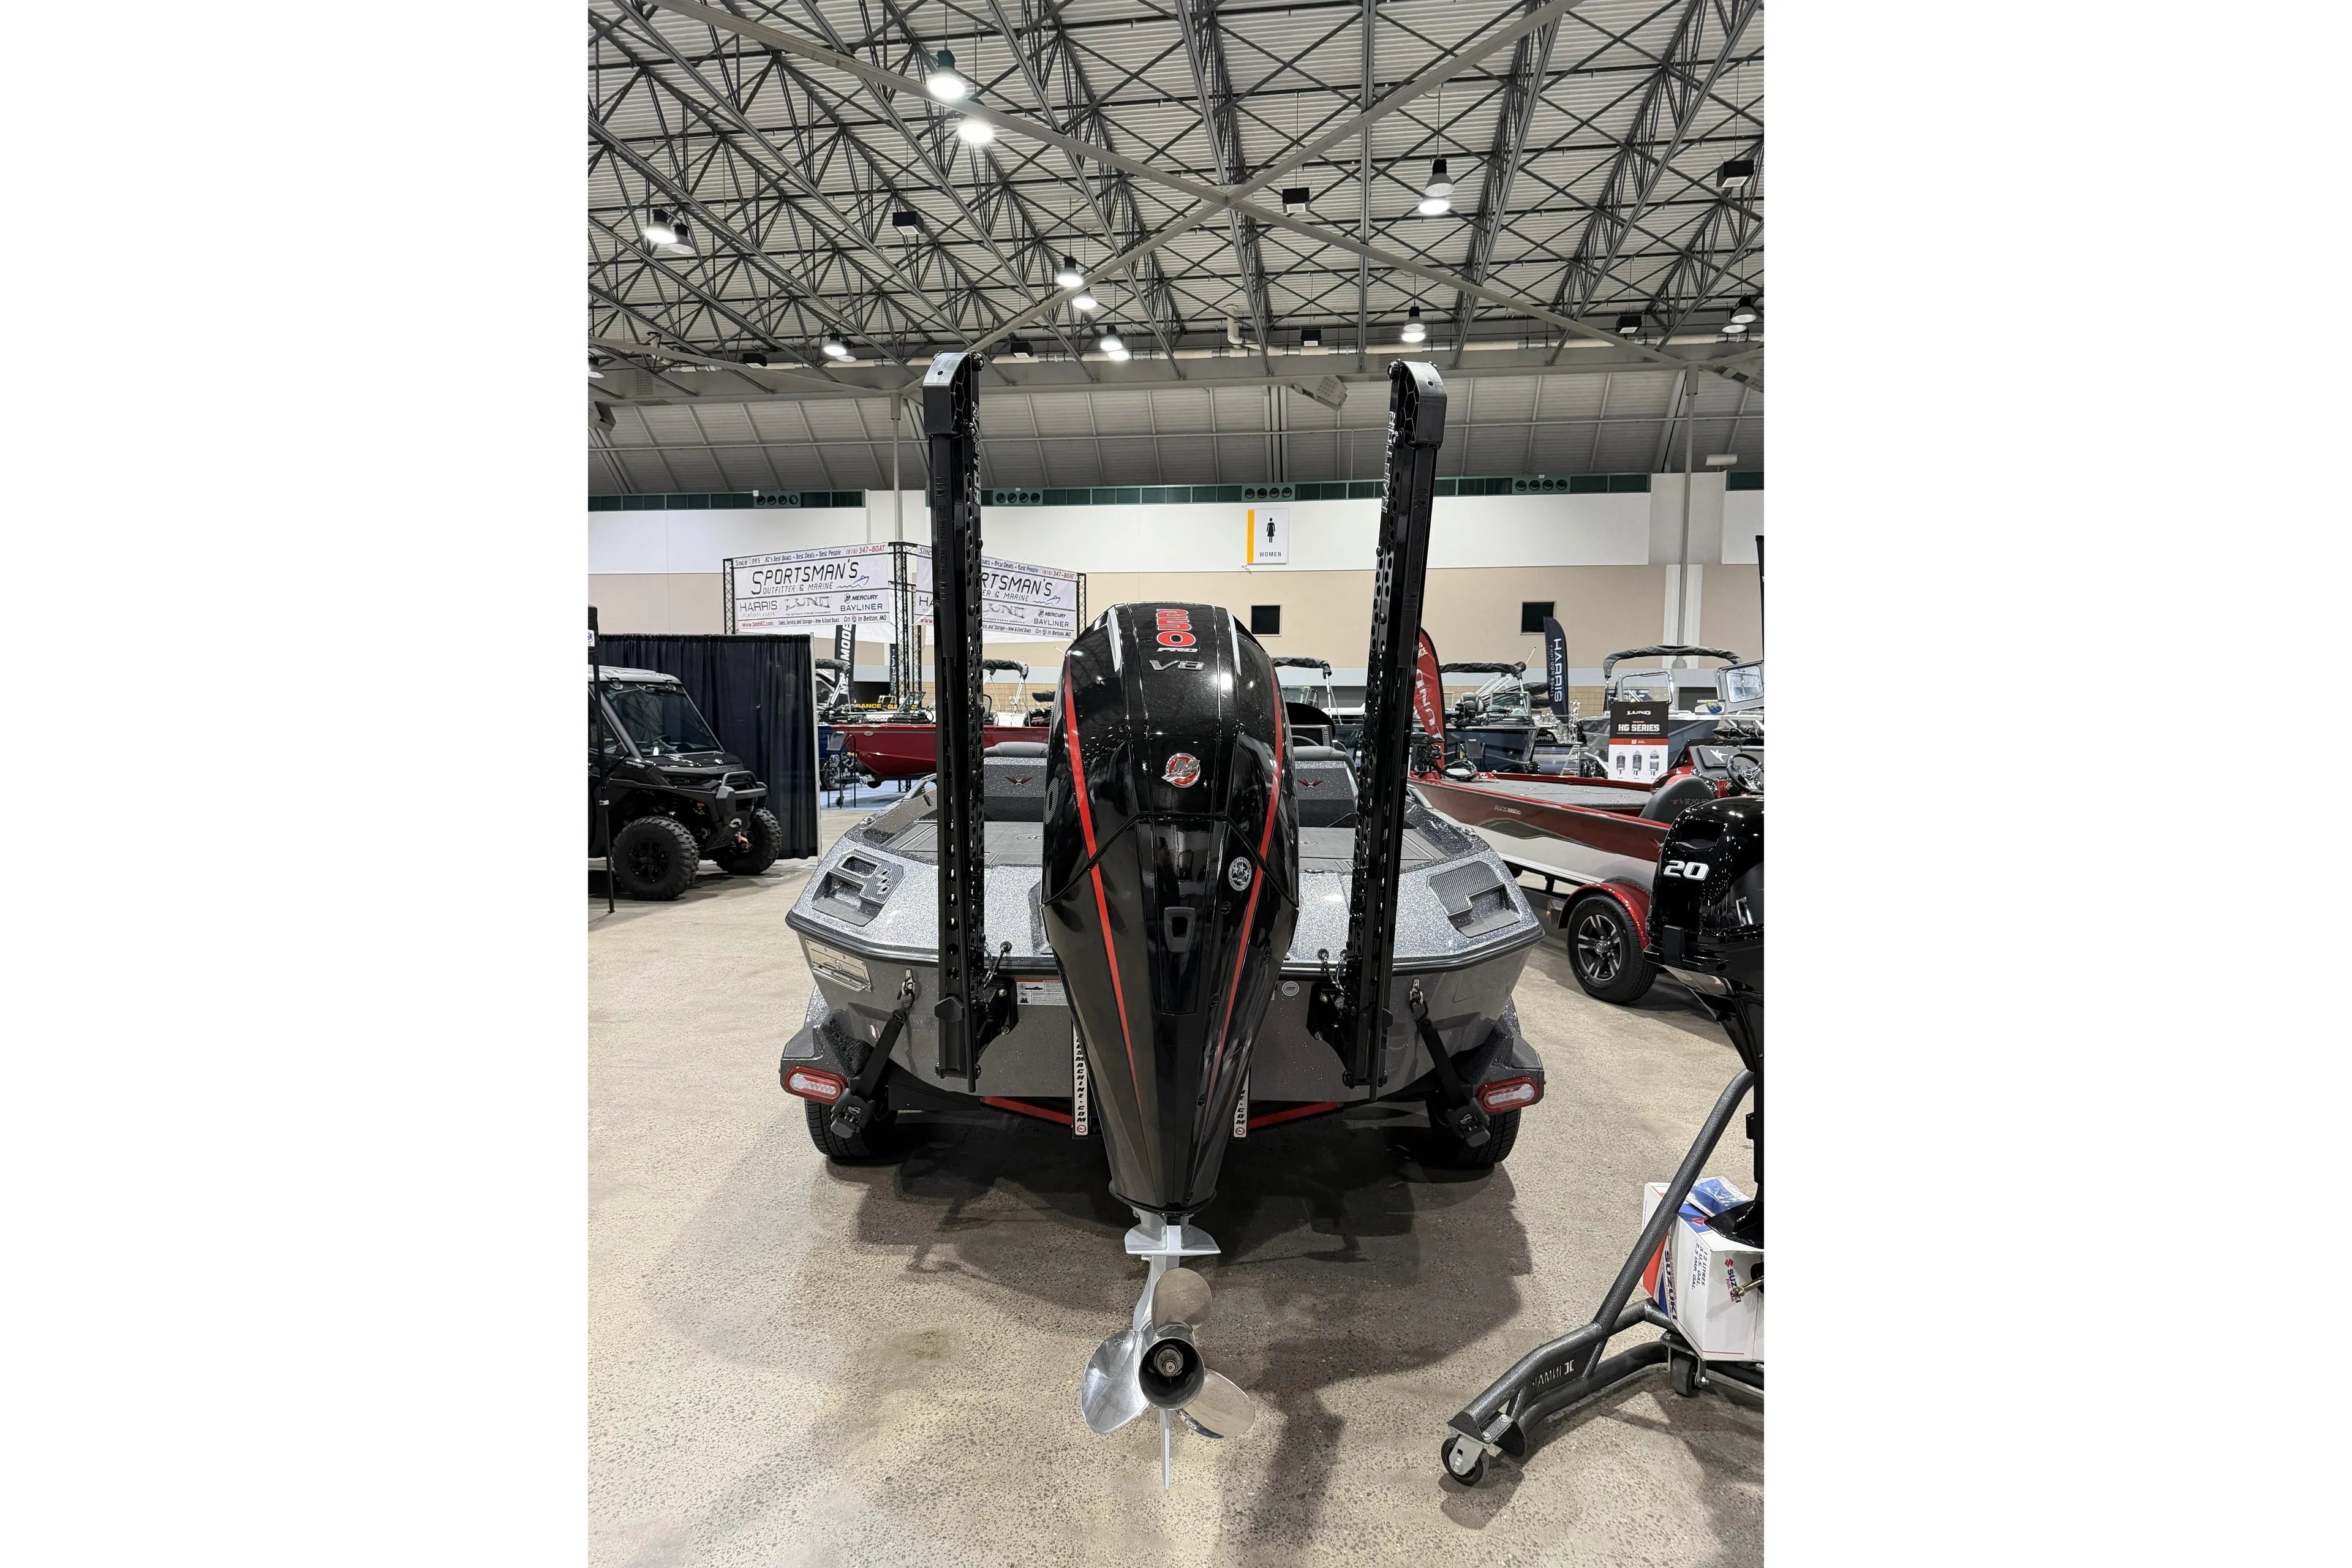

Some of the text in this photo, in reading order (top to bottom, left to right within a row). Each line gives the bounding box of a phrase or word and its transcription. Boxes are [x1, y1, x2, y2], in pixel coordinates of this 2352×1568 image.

[919, 548, 932, 556] Sinc
[751, 558, 859, 595] SPORTSMAN'S
[763, 585, 796, 594] OUTFITTER
[807, 582, 834, 591] MARINE
[981, 571, 1053, 597] RTSMAN'S
[1003, 592, 1030, 602] MARINE
[739, 600, 778, 612] HARRIS
[840, 603, 883, 612] BAYLINER
[1033, 618, 1069, 628] BAYLINER
[1155, 608, 1196, 647] 250
[1148, 659, 1205, 671] V8
[1553, 638, 1562, 703] HARRIS
[1618, 723, 1660, 732] HG SERIES
[1664, 859, 1710, 881] 20
[1703, 1250, 1708, 1261] 12
[1664, 1250, 1677, 1321] SUZUKI
[1727, 1268, 1742, 1303] SUZKI
